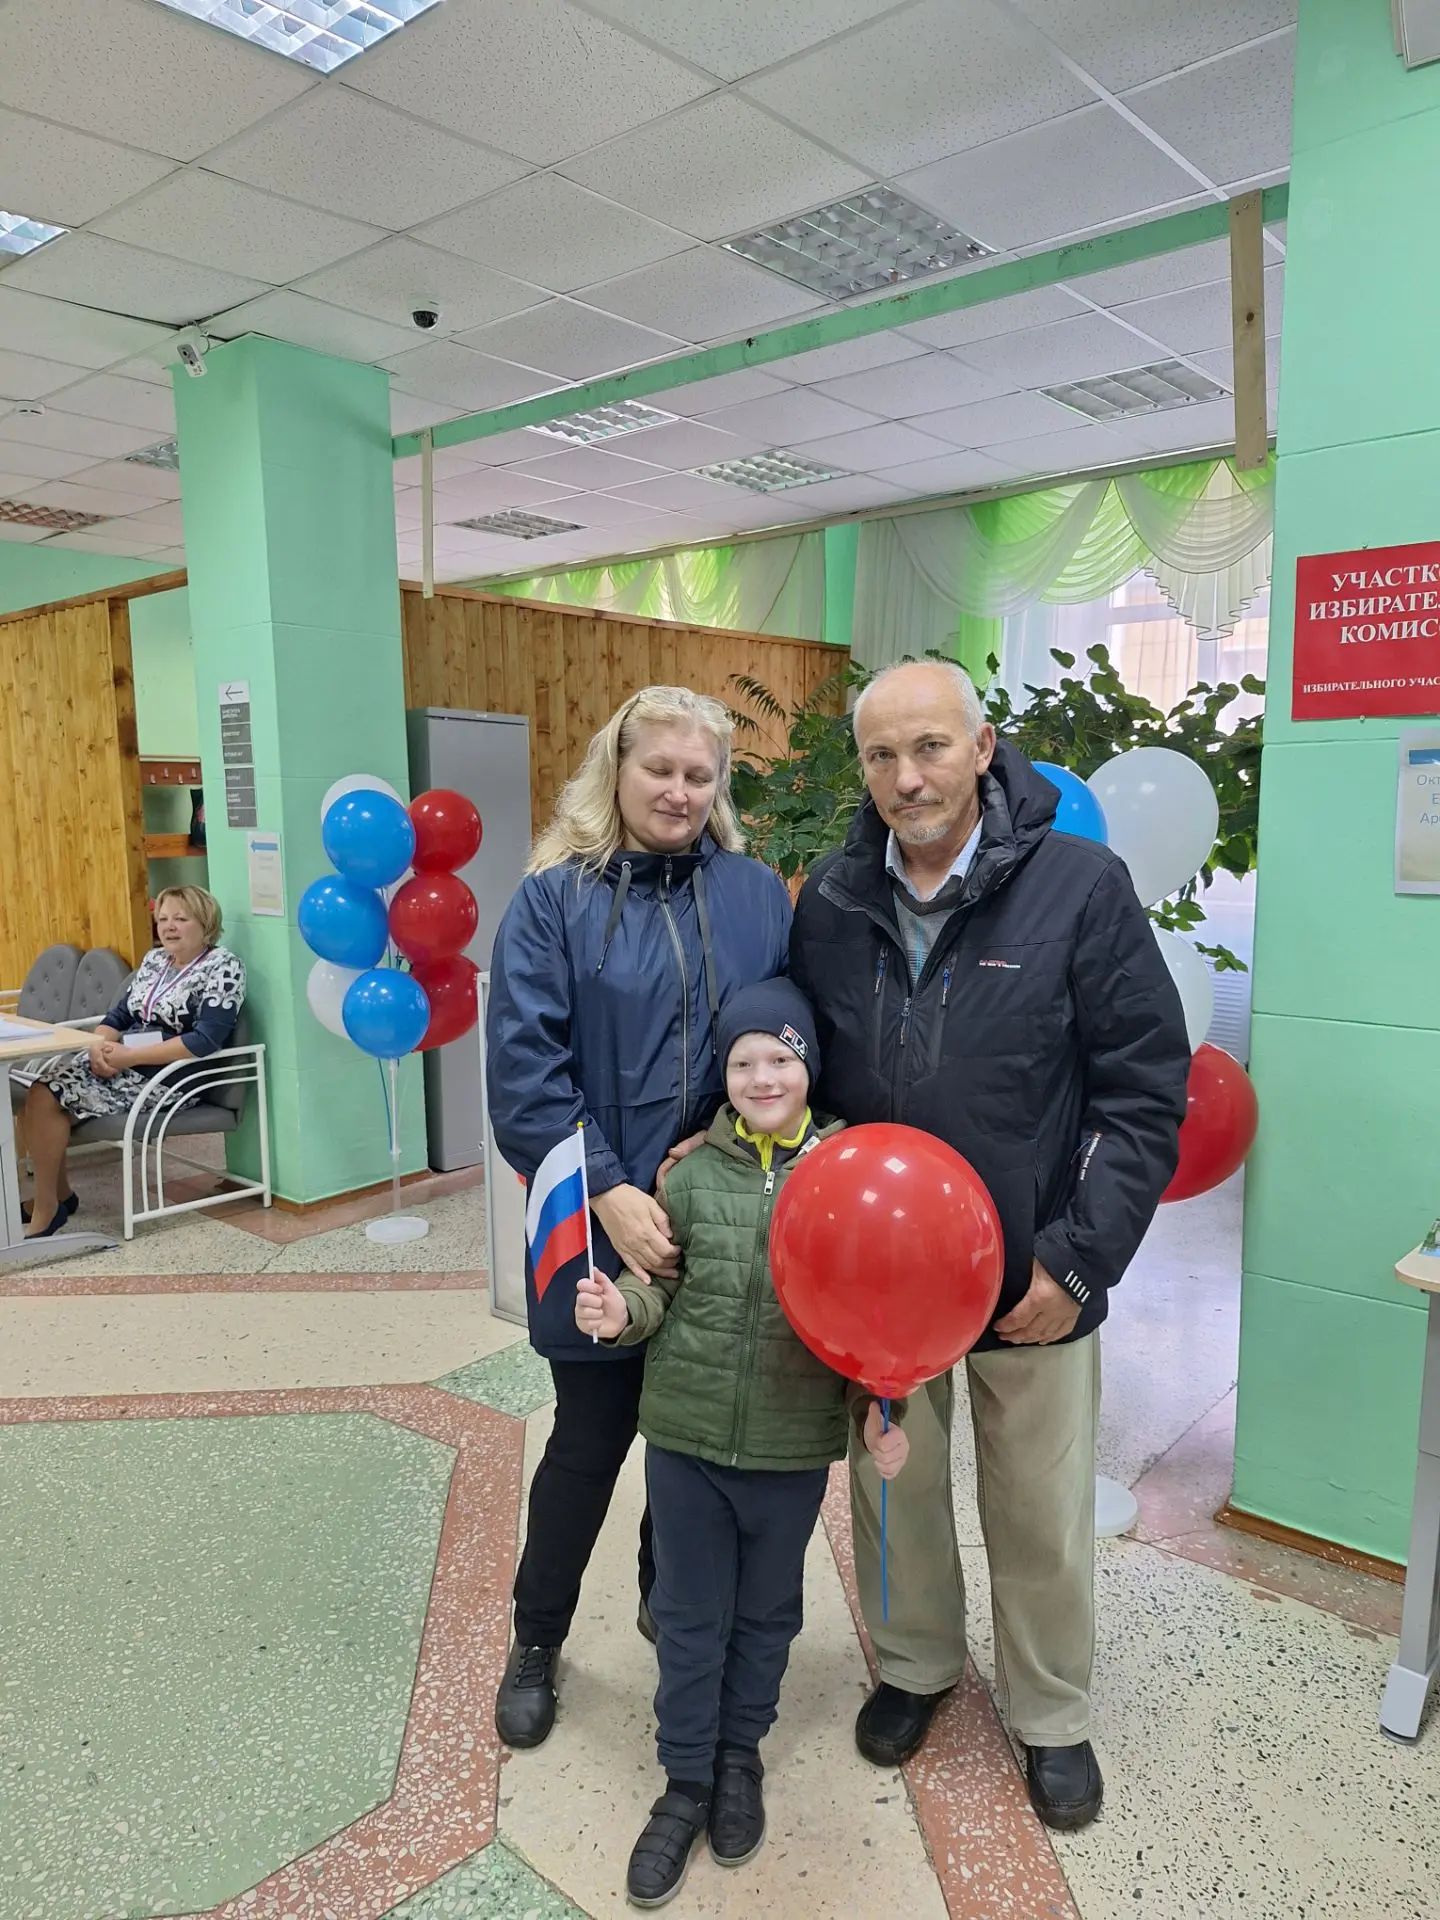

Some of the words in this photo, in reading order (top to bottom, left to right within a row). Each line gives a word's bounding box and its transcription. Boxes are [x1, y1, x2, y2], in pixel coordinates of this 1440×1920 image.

[1331, 563, 1440, 592] УЧАСТК
[1308, 591, 1440, 620] ИЗБИРАТЕ
[1340, 618, 1440, 644] КОМИС
[1303, 678, 1406, 694] ИЗБИРАТЕЛЬНОГО
[1409, 676, 1440, 687] УЧАС
[1420, 812, 1440, 825] Ар
[783, 1028, 806, 1055] FILA
